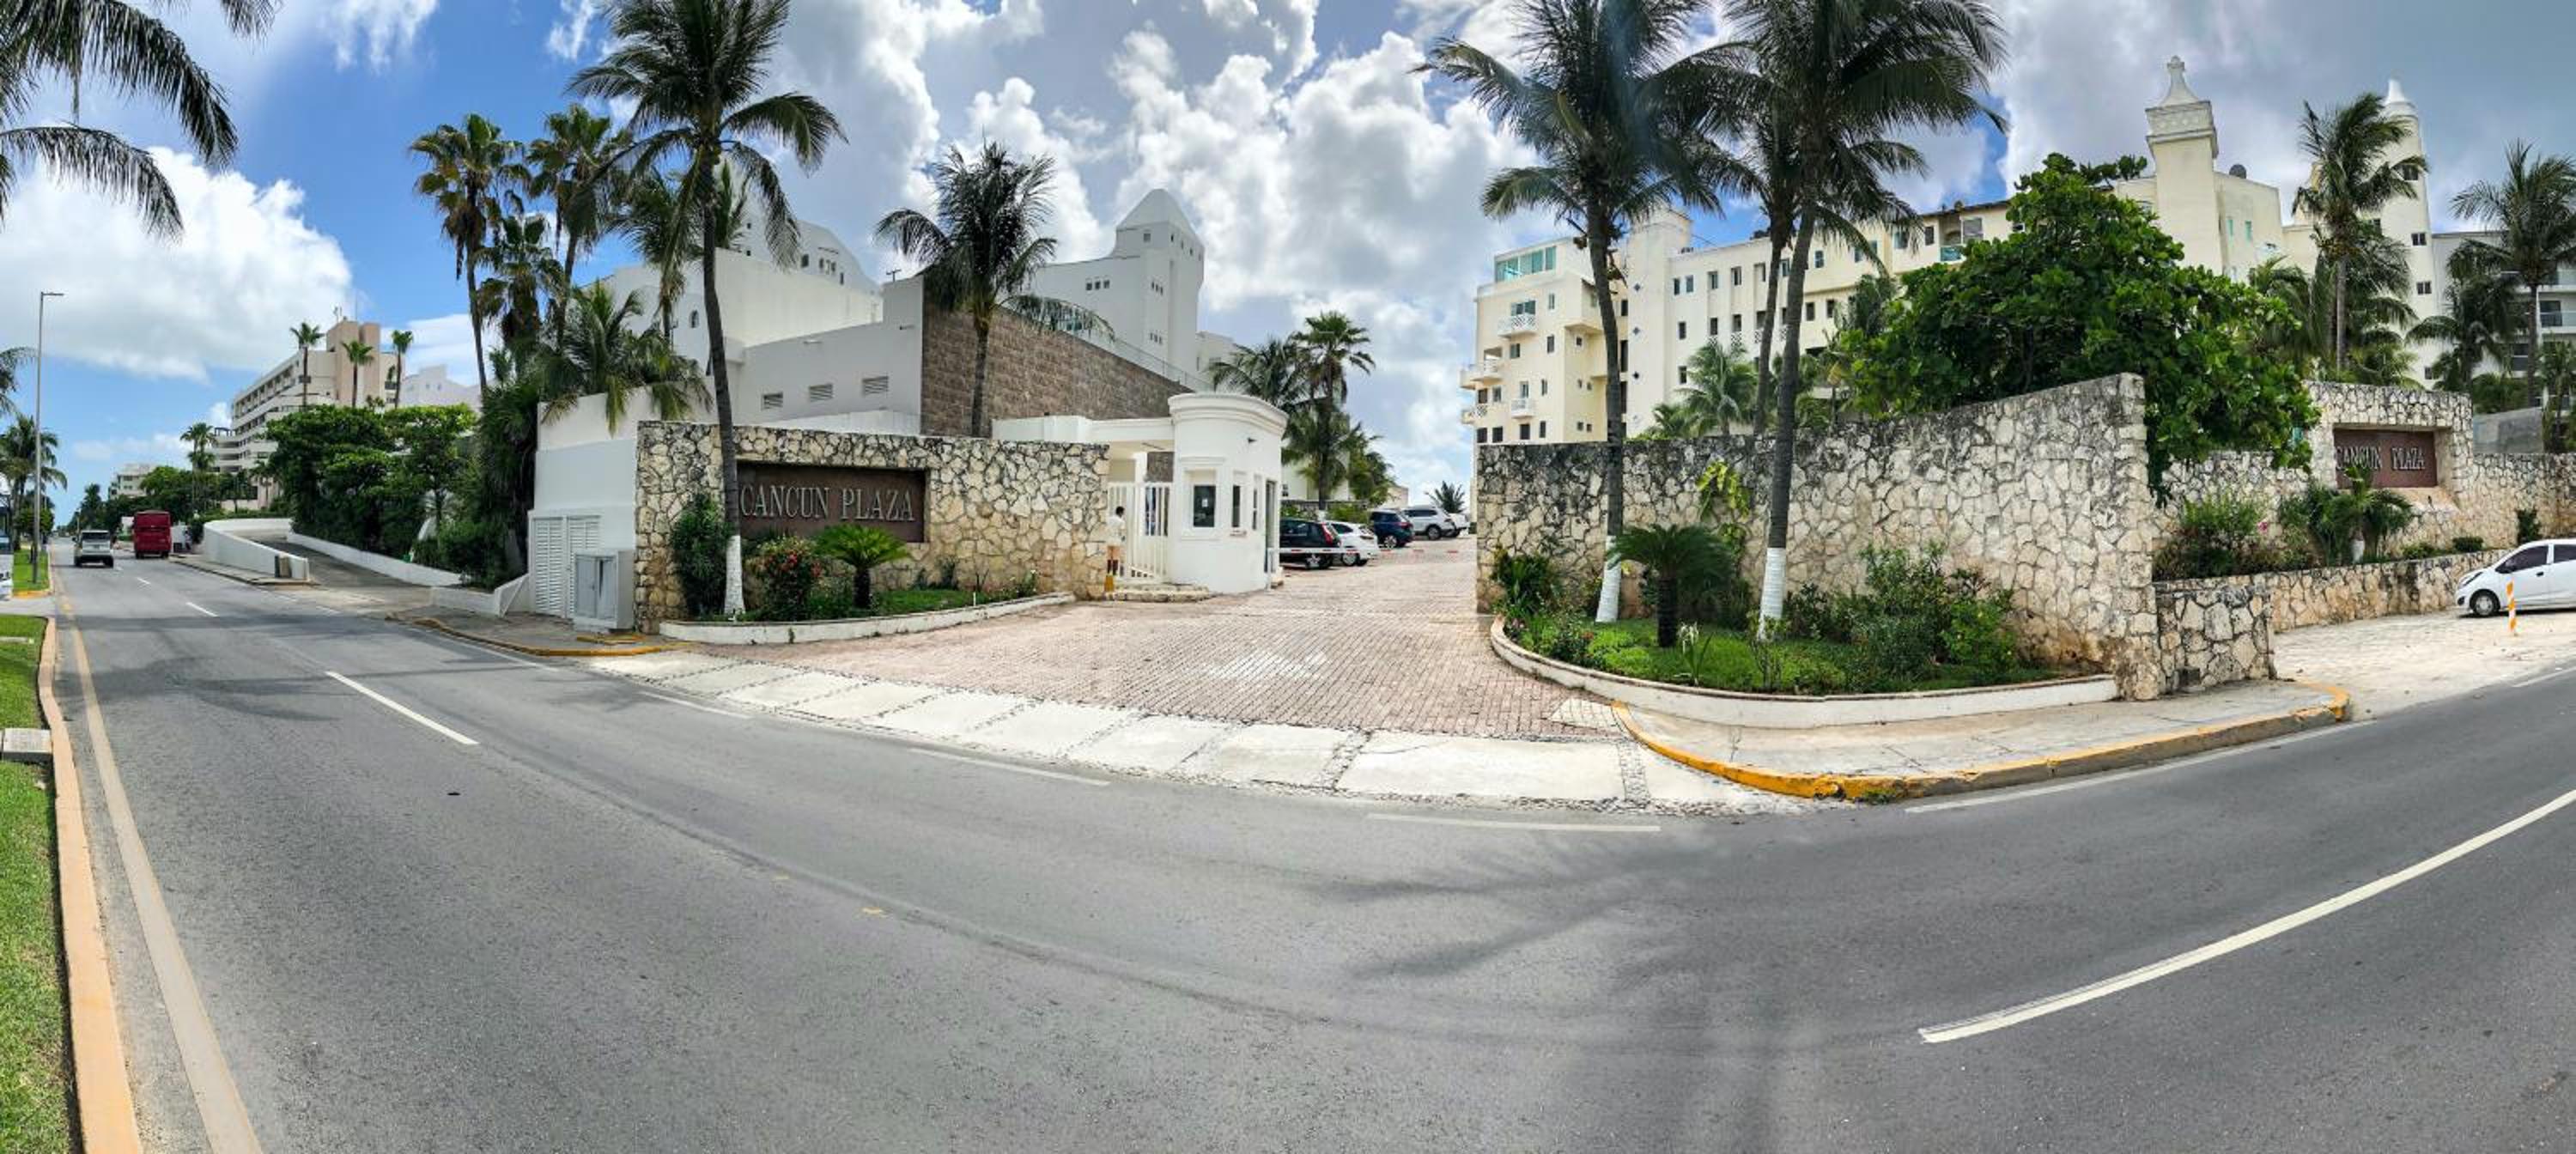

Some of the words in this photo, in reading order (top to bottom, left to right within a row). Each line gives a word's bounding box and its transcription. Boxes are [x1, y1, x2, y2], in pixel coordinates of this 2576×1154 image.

[2336, 446, 2383, 469] CANCUN
[2391, 447, 2426, 470] PLAZA
[740, 484, 829, 519] CANCUN
[840, 488, 915, 520] PLAZA
